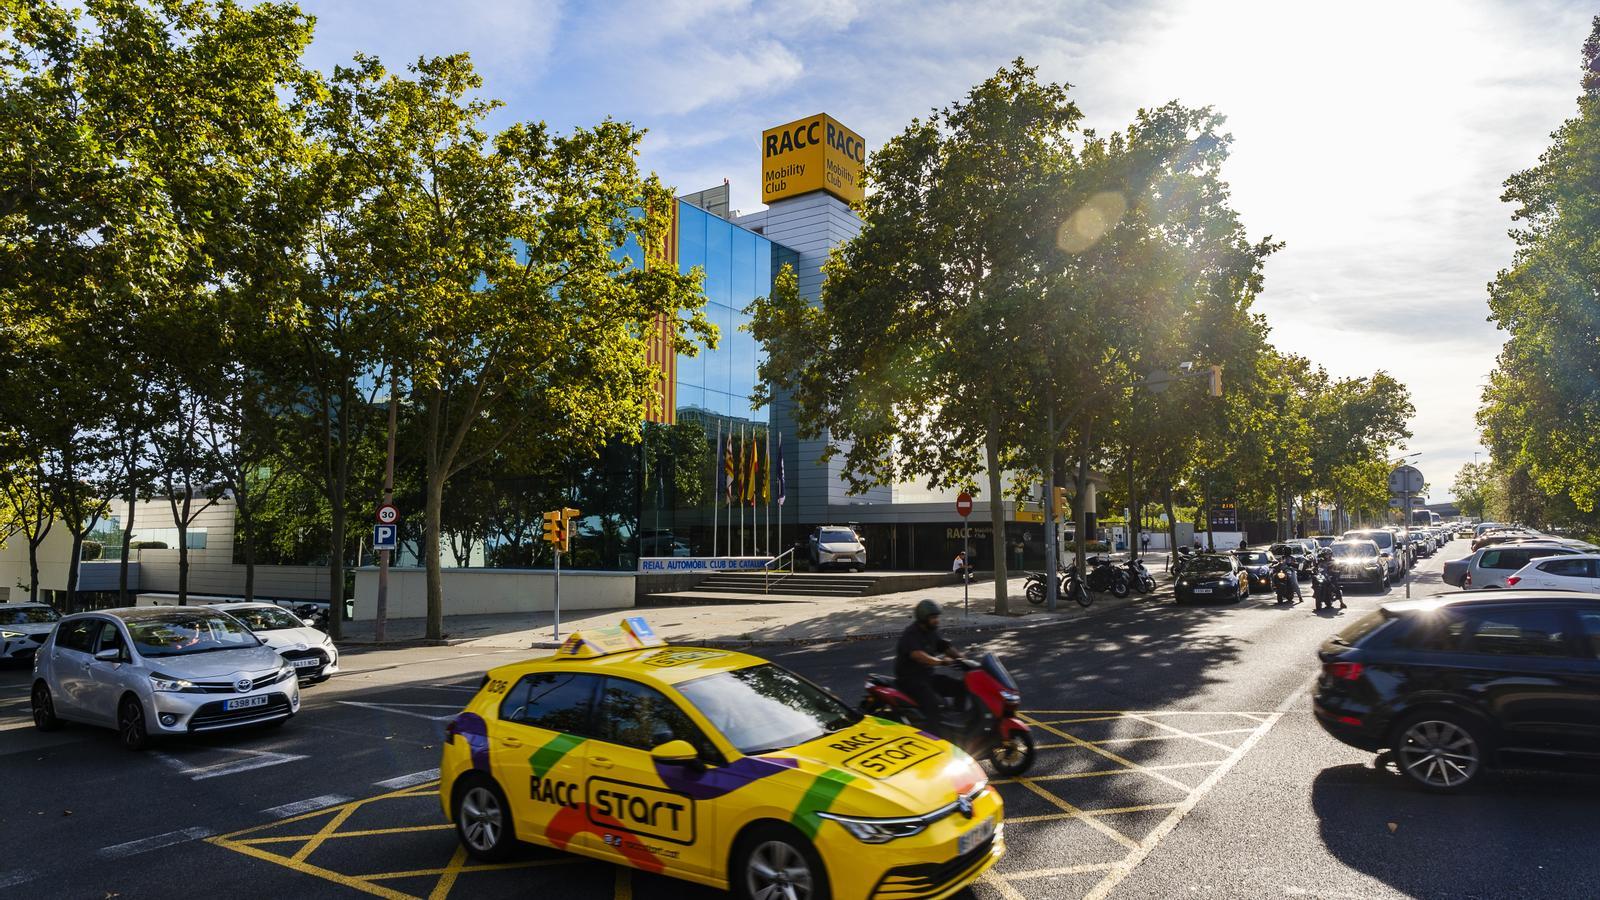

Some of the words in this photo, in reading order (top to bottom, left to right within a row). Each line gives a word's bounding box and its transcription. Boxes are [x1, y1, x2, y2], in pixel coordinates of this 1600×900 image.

[766, 121, 820, 157] RACC
[827, 123, 863, 162] RACC
[766, 164, 806, 182] Mobility
[826, 159, 854, 185] Mobility
[826, 172, 842, 188] Club
[765, 180, 787, 194] Club
[377, 527, 391, 544] P
[642, 560, 664, 570] REIAL
[710, 560, 727, 569] CLUB
[729, 560, 737, 568] DE
[228, 699, 250, 709] 4398
[251, 695, 267, 706] KTM
[829, 732, 882, 753] RACC
[529, 775, 580, 810] RACC
